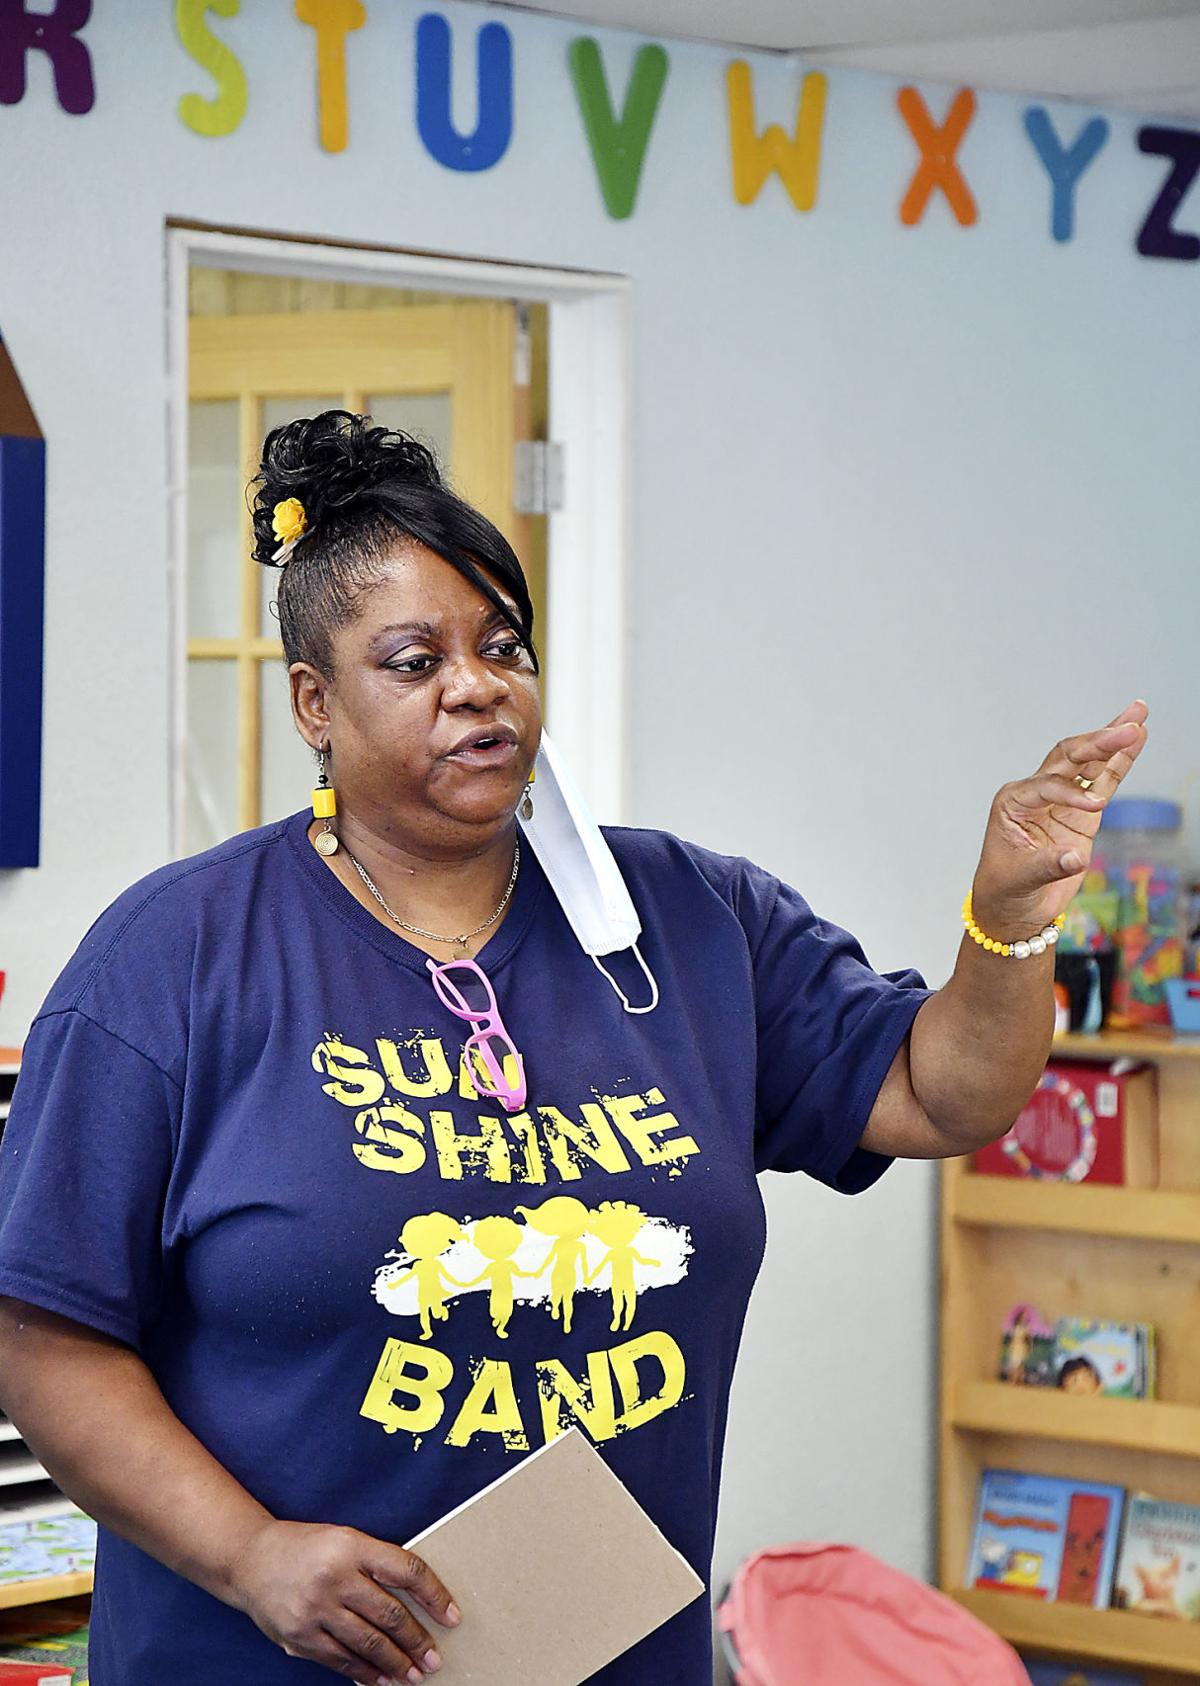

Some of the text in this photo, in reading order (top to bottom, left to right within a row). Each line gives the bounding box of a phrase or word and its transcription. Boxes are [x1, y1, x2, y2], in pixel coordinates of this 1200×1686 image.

[174, 0, 249, 137] S
[295, 0, 367, 153] T
[416, 13, 513, 172] U
[568, 35, 669, 220] V
[727, 59, 827, 212] W
[897, 86, 978, 227] X
[1023, 105, 1110, 243] Y
[1136, 124, 1200, 261] Z
[352, 1087, 701, 1184] SHINE
[360, 1331, 687, 1451] BAND
